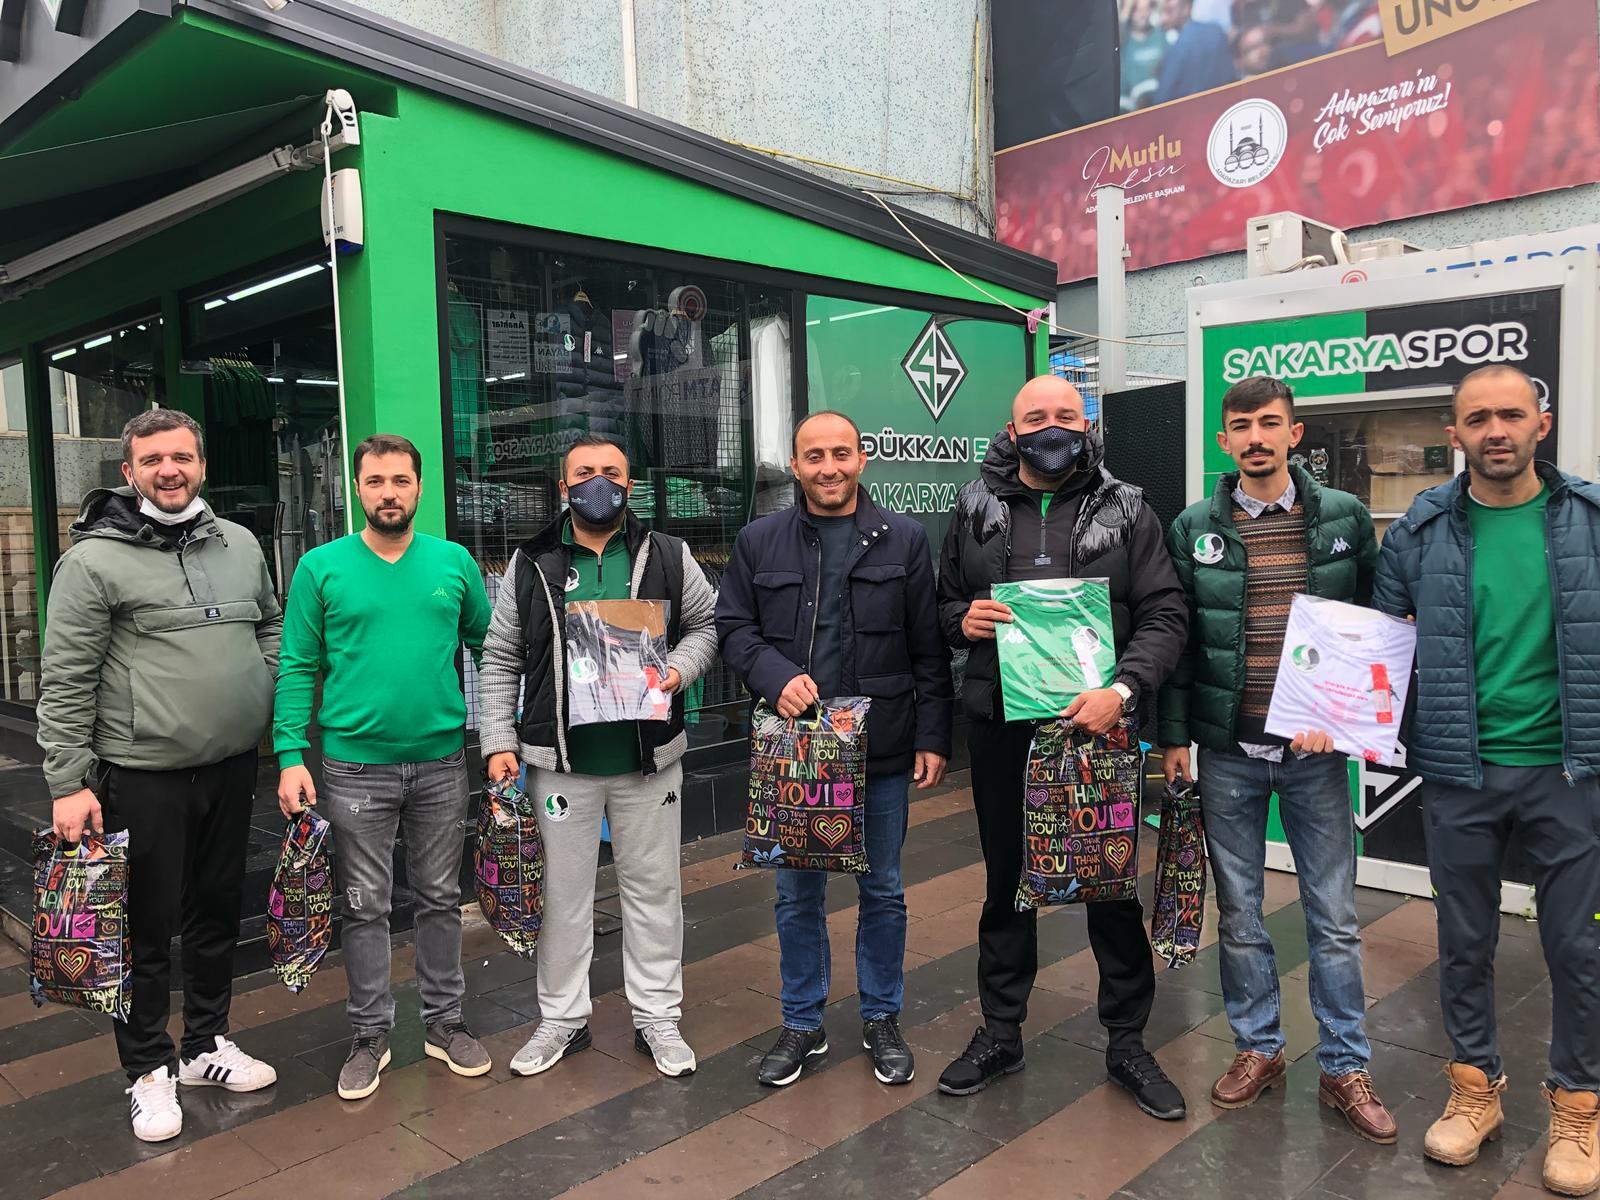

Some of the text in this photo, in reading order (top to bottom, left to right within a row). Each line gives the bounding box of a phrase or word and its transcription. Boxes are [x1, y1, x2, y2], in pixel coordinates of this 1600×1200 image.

[1313, 82, 1452, 153] Çok Seviyoruz!
[1109, 134, 1182, 174] Mutlu
[1225, 325, 1526, 381] SAKARYASPOR
[861, 429, 968, 462] DÜKKAN
[811, 739, 839, 749] THANK
[813, 748, 839, 760] YOU!
[776, 758, 830, 780] THANK
[776, 780, 831, 806] YOU!
[1027, 811, 1057, 822] THANK
[1068, 804, 1115, 832] YOU!
[779, 825, 807, 836] THANK
[1029, 821, 1057, 835] YOU!
[780, 835, 807, 849] YOU!
[1027, 836, 1072, 852] THANK
[1030, 853, 1072, 874] YOU!
[1074, 855, 1101, 866] THANK
[1076, 865, 1101, 879] YOU!
[83, 986, 118, 1001] THANK
